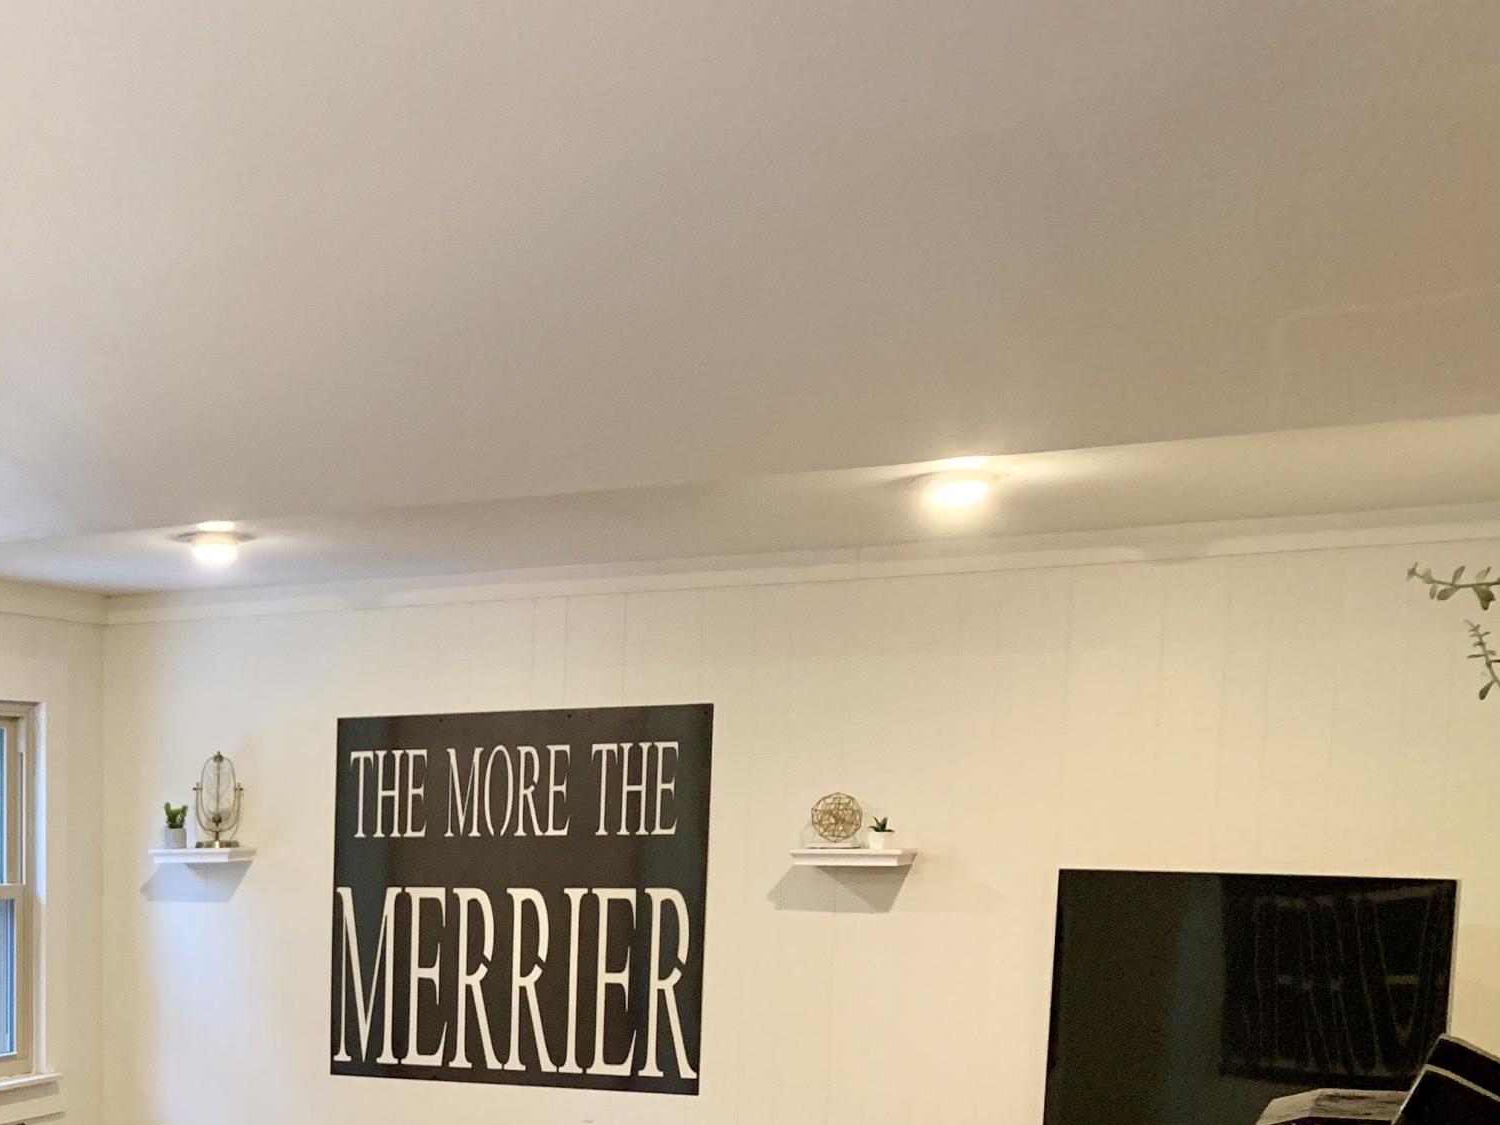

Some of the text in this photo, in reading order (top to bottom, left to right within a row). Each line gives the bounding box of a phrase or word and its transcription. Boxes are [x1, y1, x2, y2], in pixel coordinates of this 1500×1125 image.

[350, 741, 679, 838] THE MORE THE
[333, 886, 698, 1079] MERRIER
